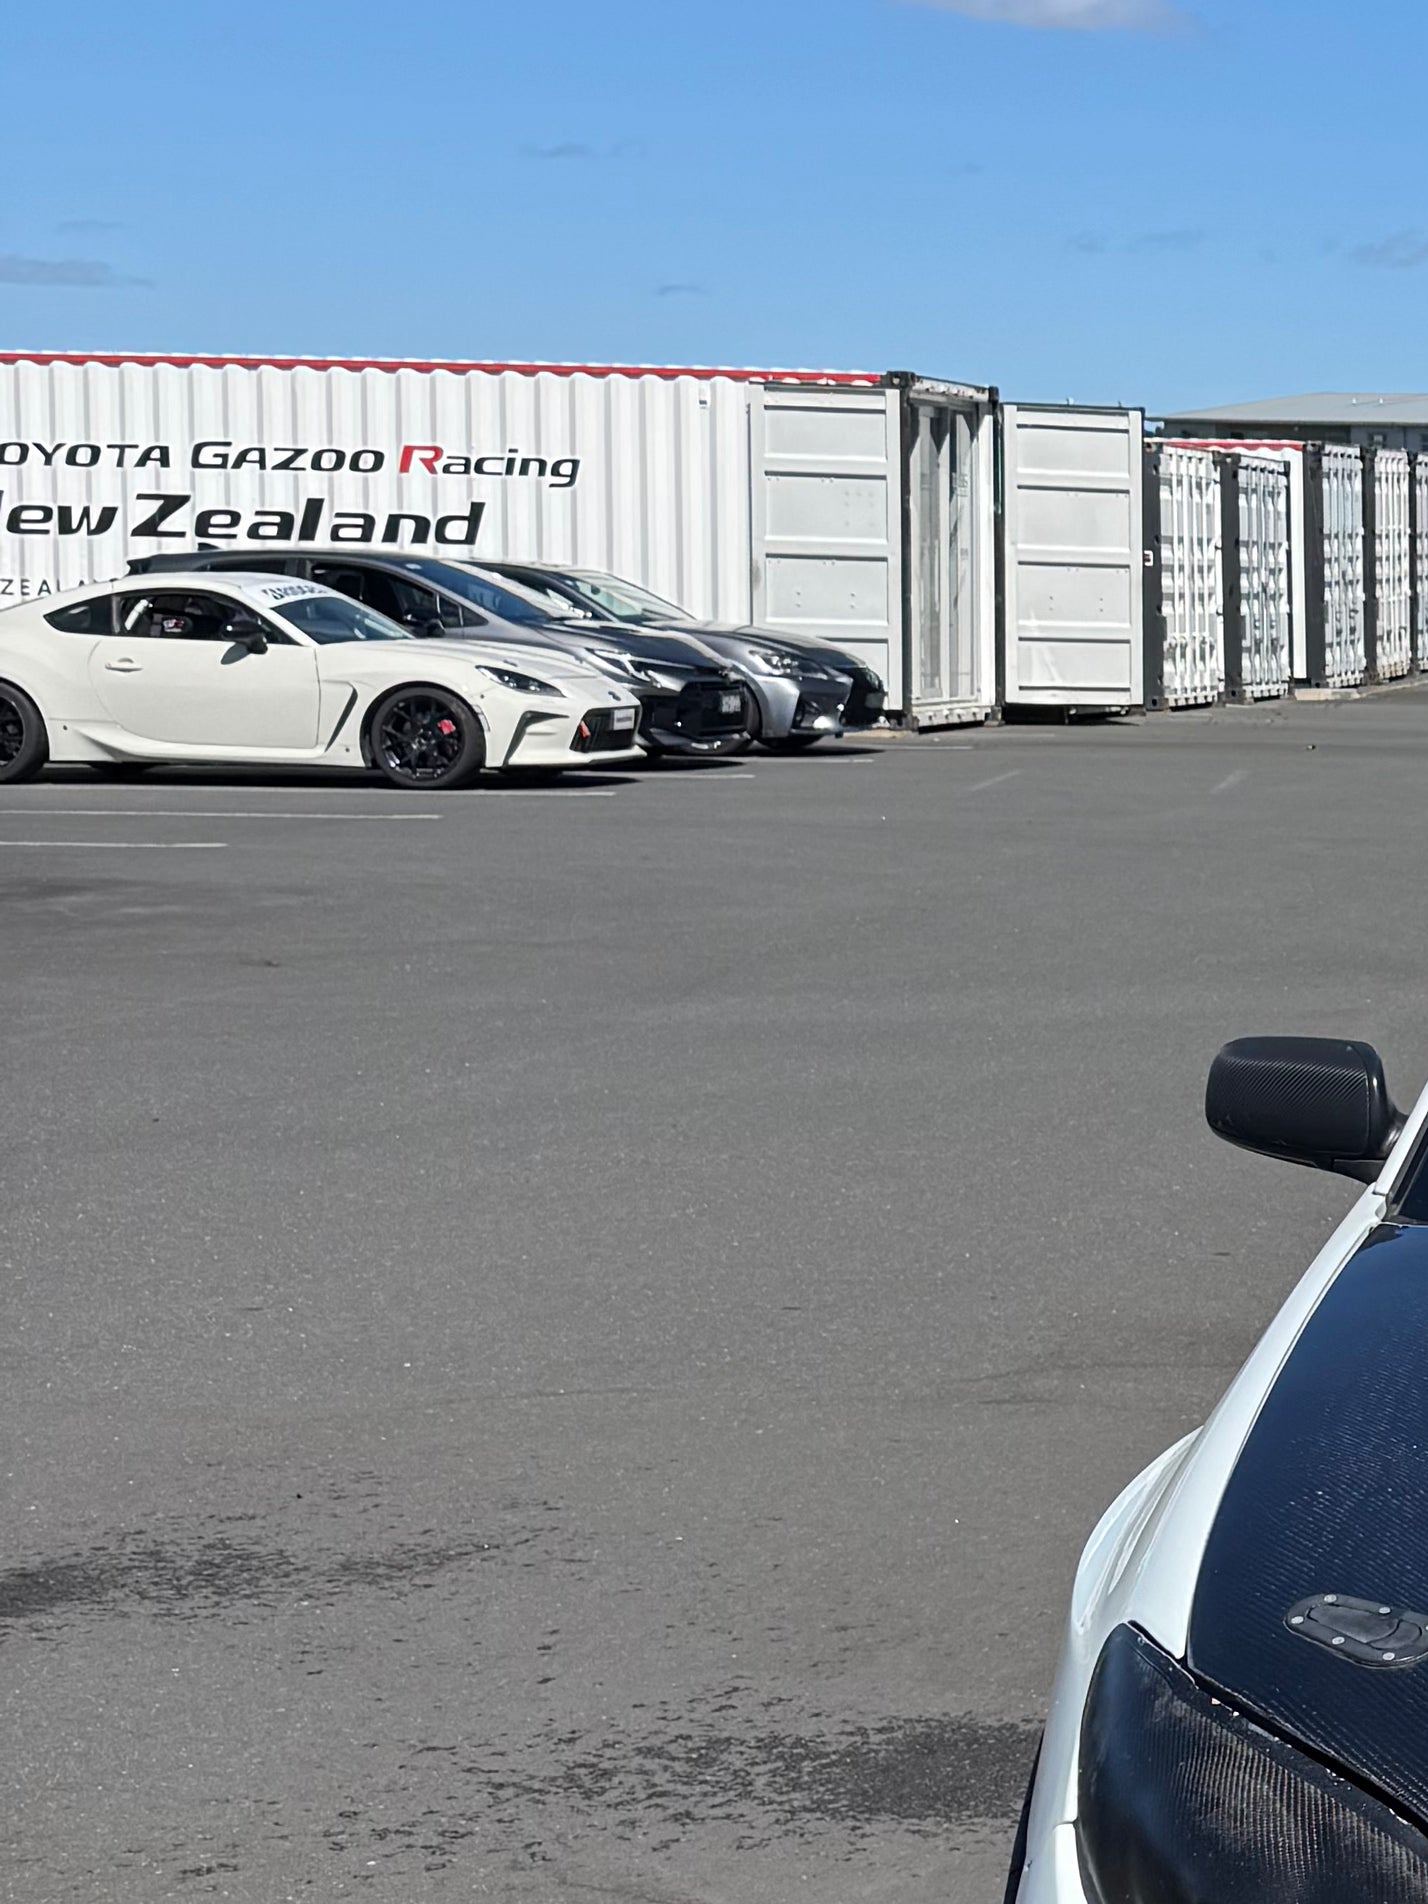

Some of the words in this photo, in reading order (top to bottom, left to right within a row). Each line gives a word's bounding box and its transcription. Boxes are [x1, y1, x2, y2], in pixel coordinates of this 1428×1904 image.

[0, 441, 171, 468] OYOTA
[191, 441, 385, 473] GAZOO
[400, 444, 580, 488] Racing
[0, 490, 119, 536] ew
[130, 493, 486, 546] Zealand
